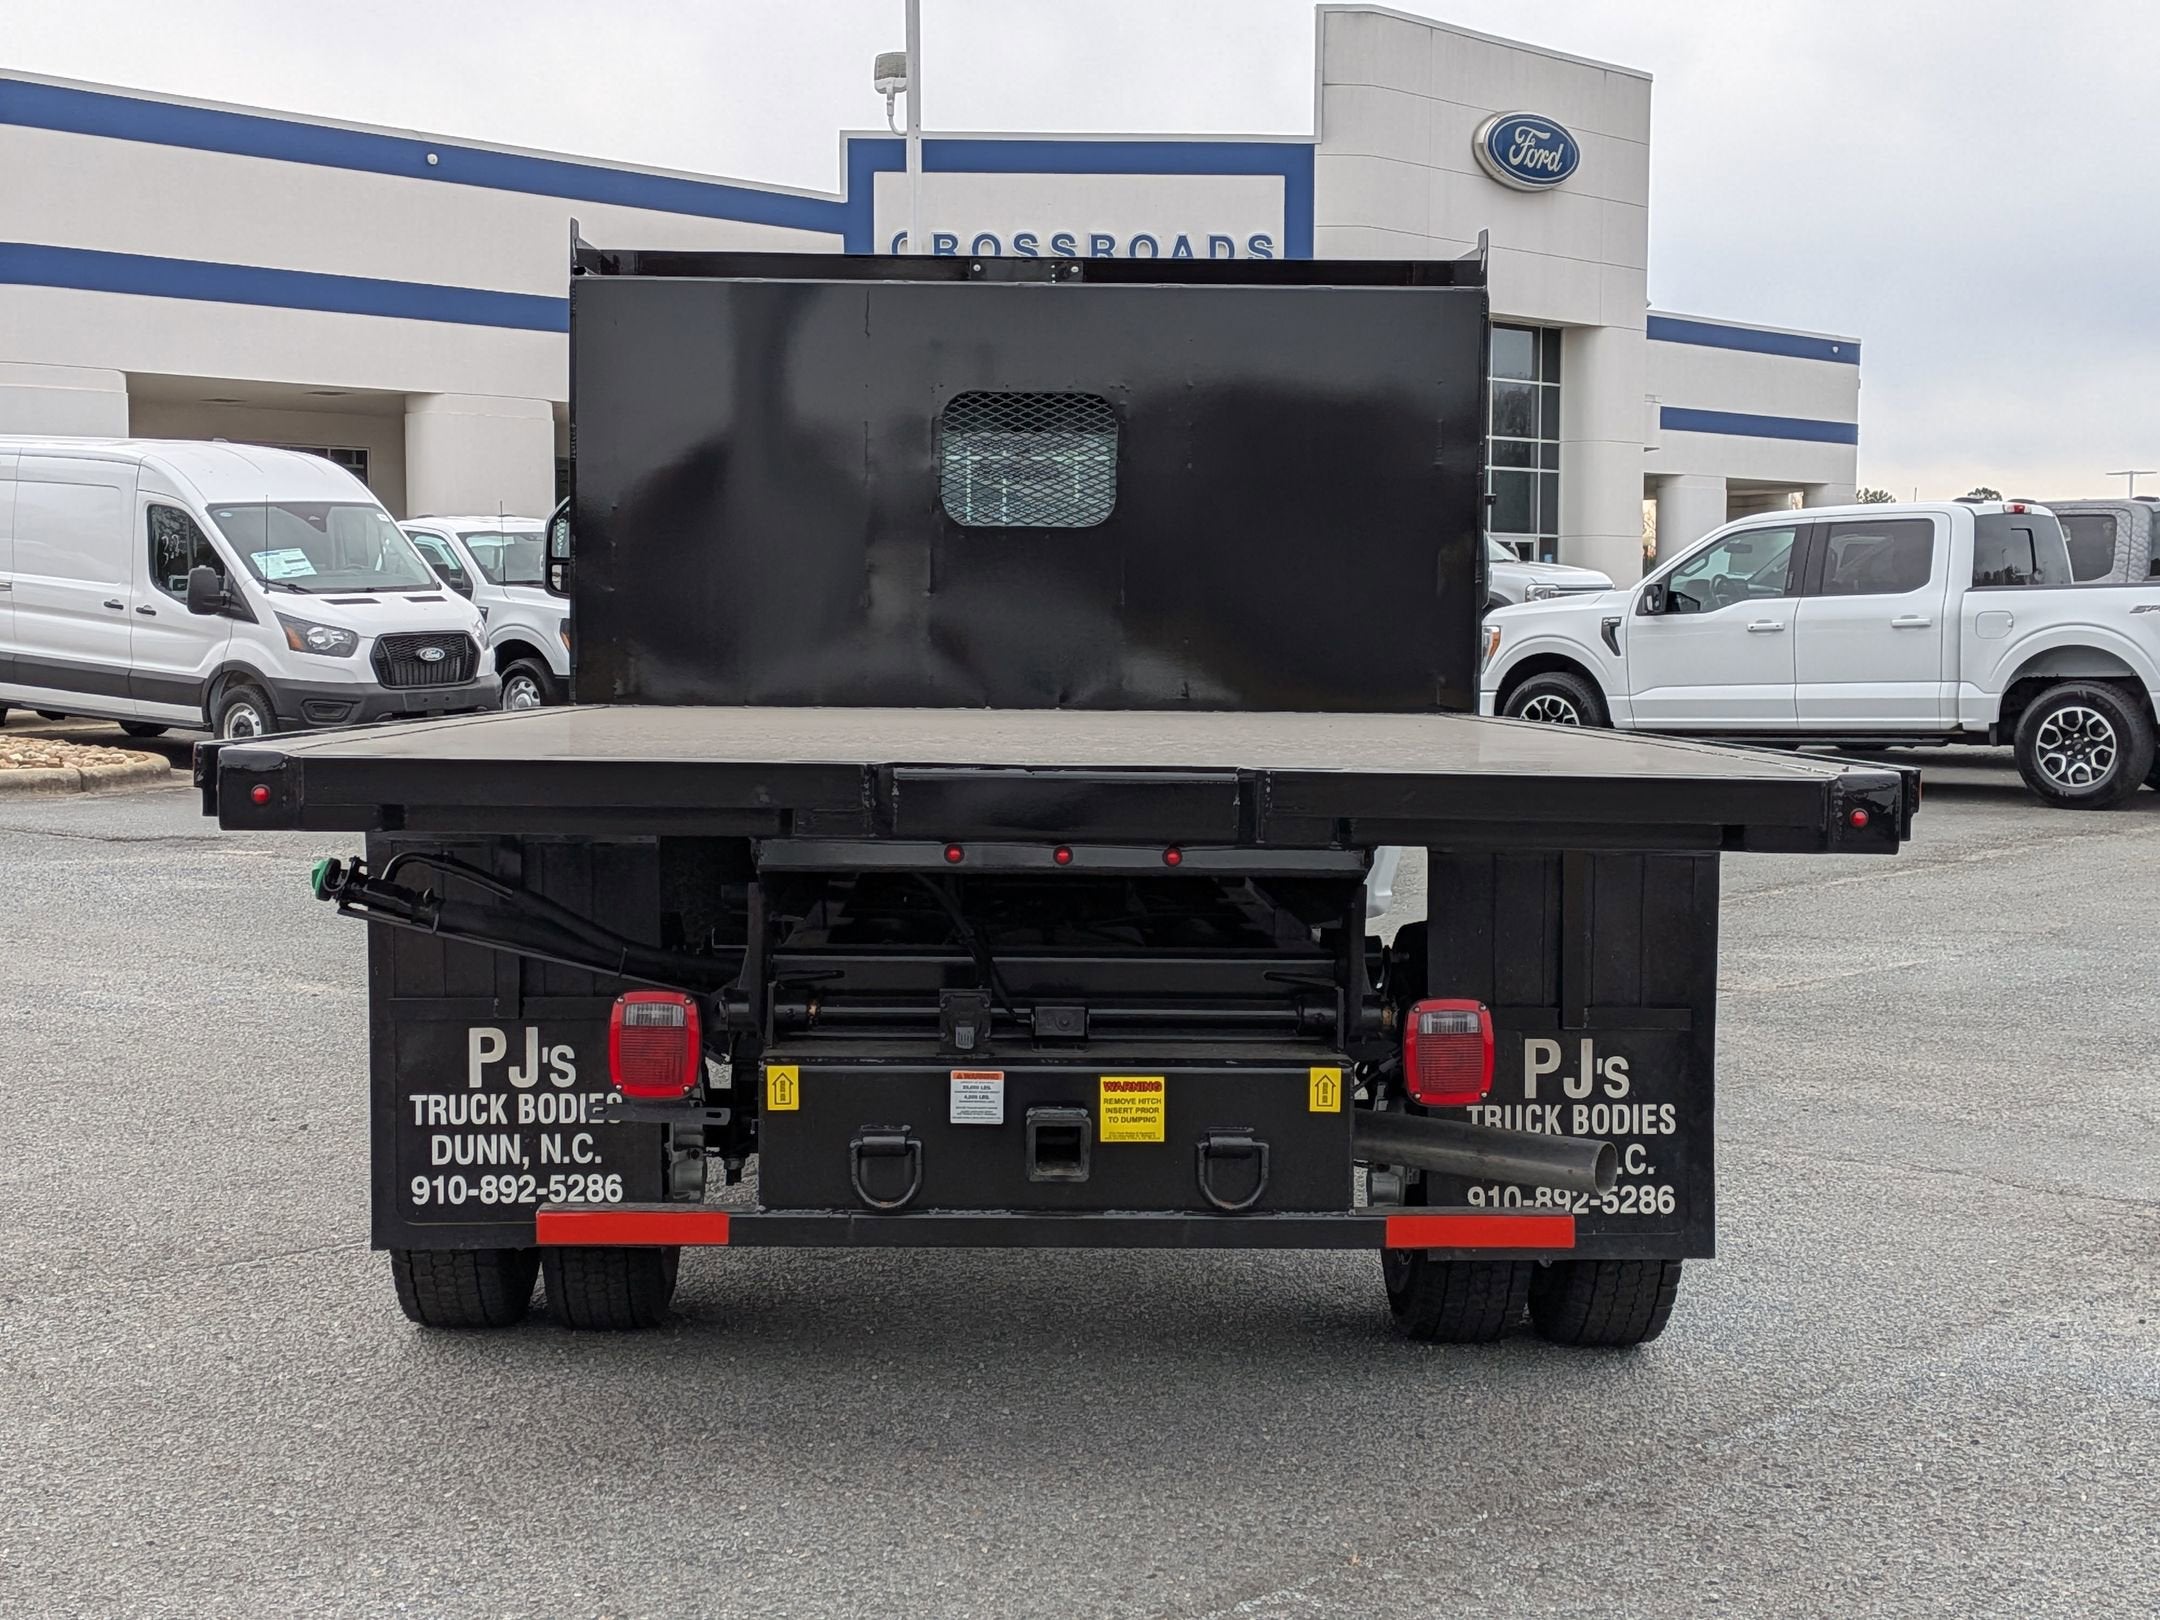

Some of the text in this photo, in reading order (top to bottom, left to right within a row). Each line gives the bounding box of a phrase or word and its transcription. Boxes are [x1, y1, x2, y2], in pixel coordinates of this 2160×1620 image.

[1509, 126, 1564, 173] Ford
[468, 1027, 577, 1089] PJ's
[1524, 1038, 1630, 1100] PJ's
[1103, 1081, 1162, 1093] WARNING
[409, 1093, 508, 1126] TRUCK
[1467, 1104, 1677, 1135] TRUCK BODIES
[431, 1132, 603, 1170] DUNN, N.C.
[411, 1174, 623, 1205] 910-892-5286
[1467, 1185, 1676, 1216] 910-892-5286
